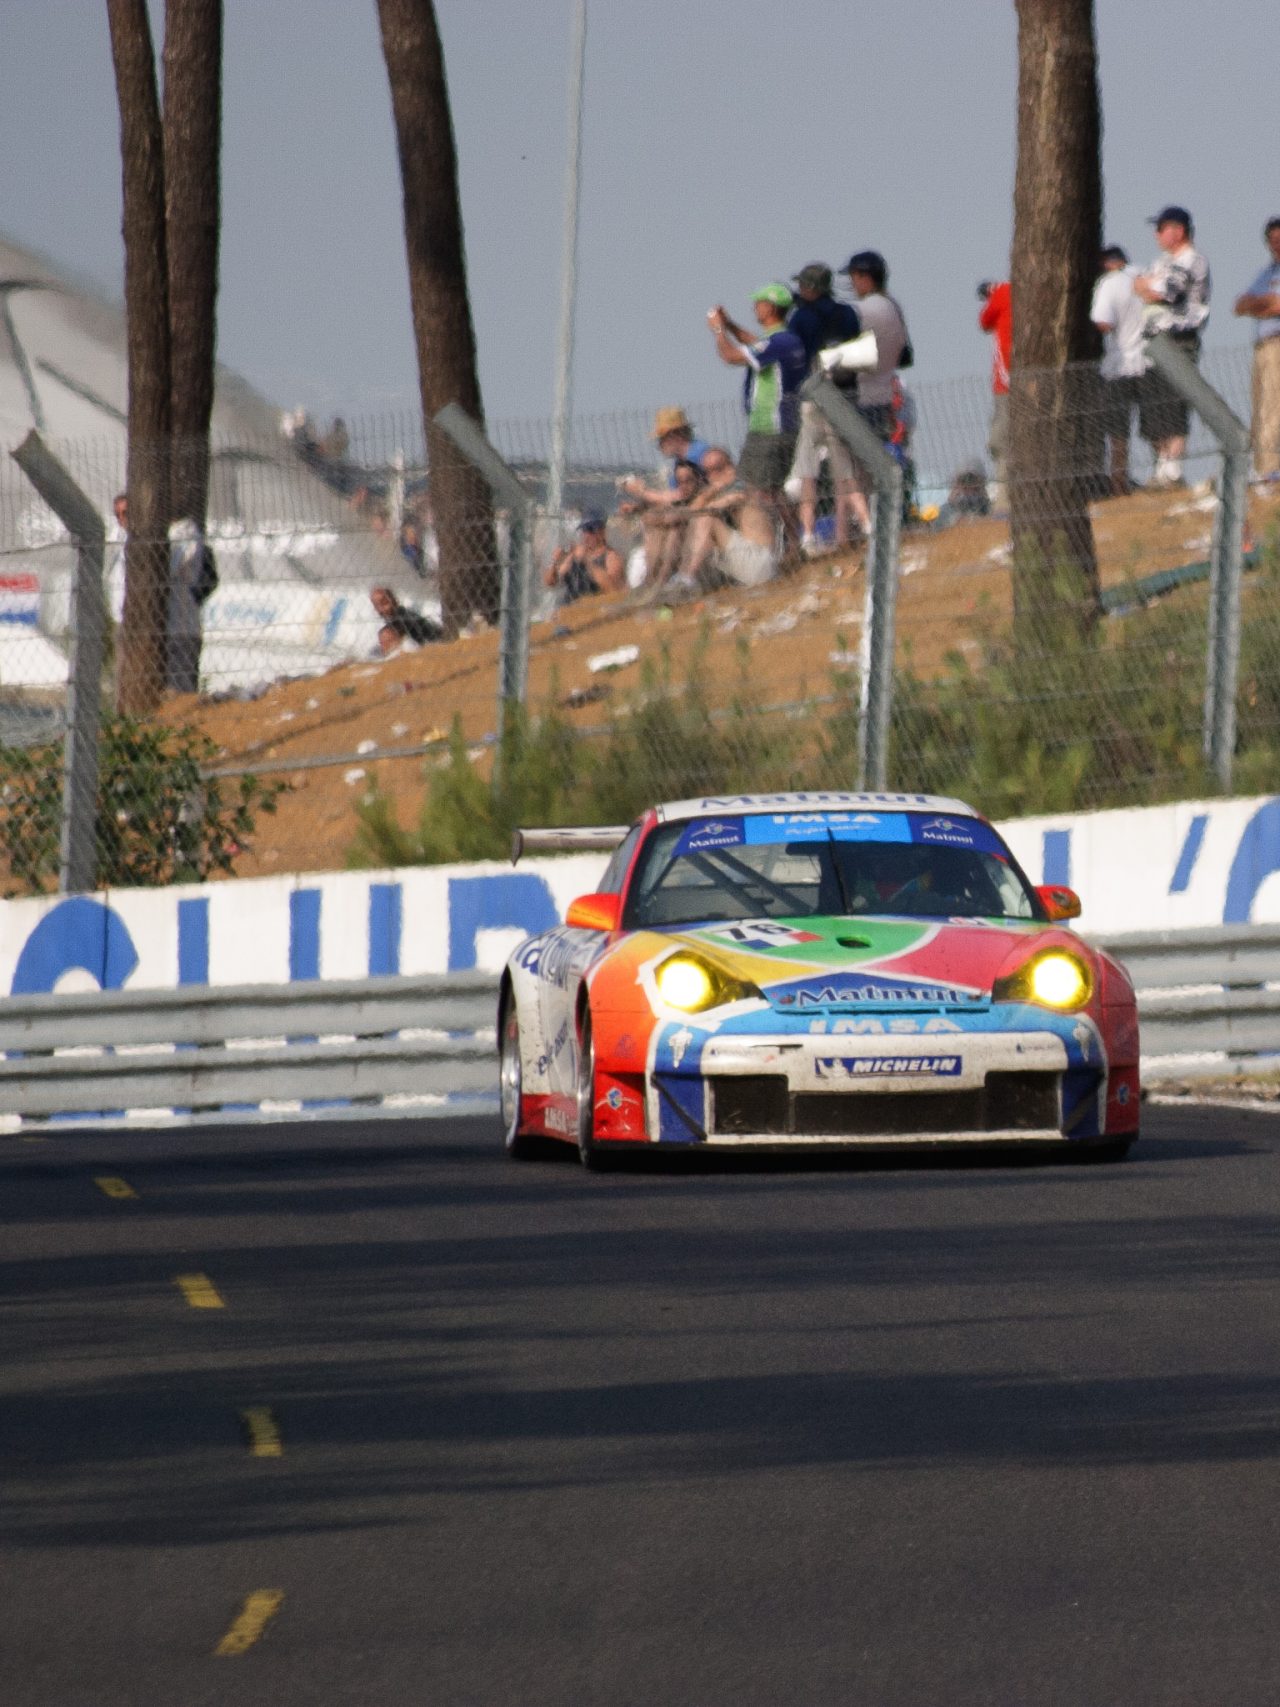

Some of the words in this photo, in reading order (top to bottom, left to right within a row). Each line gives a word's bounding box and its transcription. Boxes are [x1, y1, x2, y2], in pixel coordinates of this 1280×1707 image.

[688, 834, 740, 848] Matmut
[797, 985, 964, 1006] Matmut
[809, 1018, 963, 1034] IMSA
[850, 1056, 959, 1074] MICHELIN
